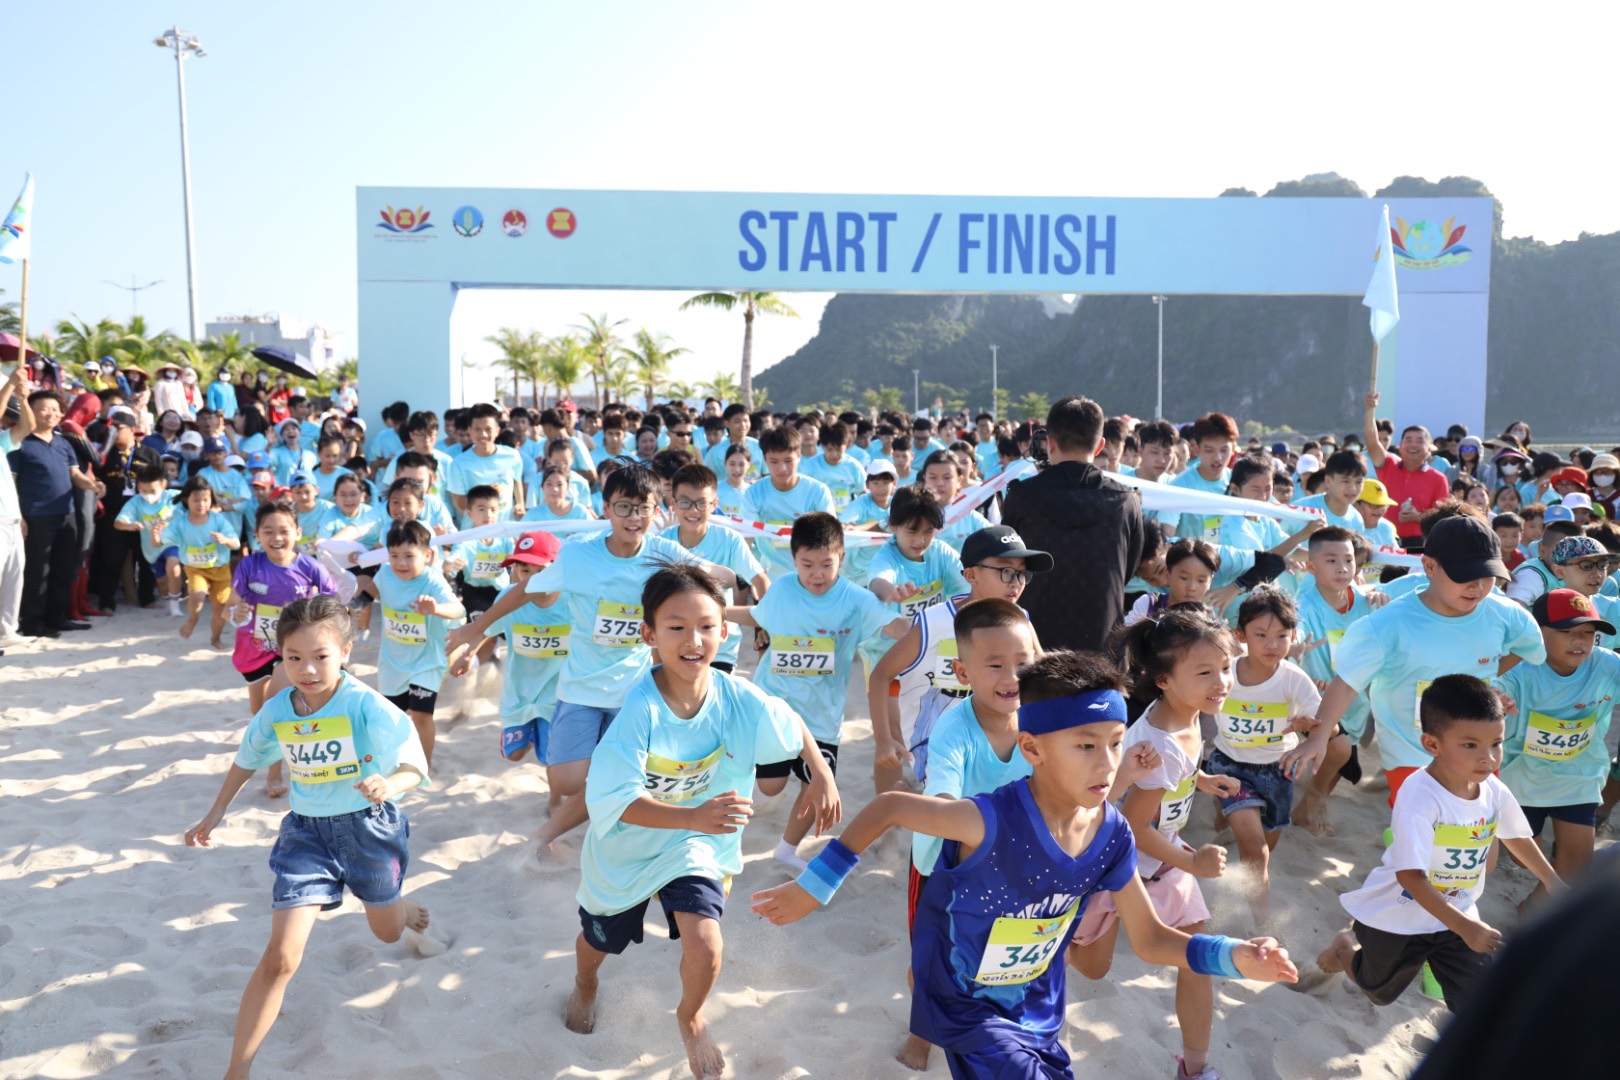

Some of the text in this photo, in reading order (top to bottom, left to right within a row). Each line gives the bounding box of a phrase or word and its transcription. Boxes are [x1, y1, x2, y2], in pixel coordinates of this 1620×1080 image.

[738, 210, 1117, 275] START / FINISH
[905, 592, 942, 617] 3760
[388, 618, 421, 636] 3494
[598, 619, 641, 636] 375
[521, 635, 561, 649] 3375
[776, 653, 829, 669] 3877
[1228, 716, 1275, 735] 3341
[1536, 730, 1589, 749] 3484
[286, 740, 342, 765] 3449
[645, 770, 710, 793] 3754
[999, 936, 1060, 969] 349
